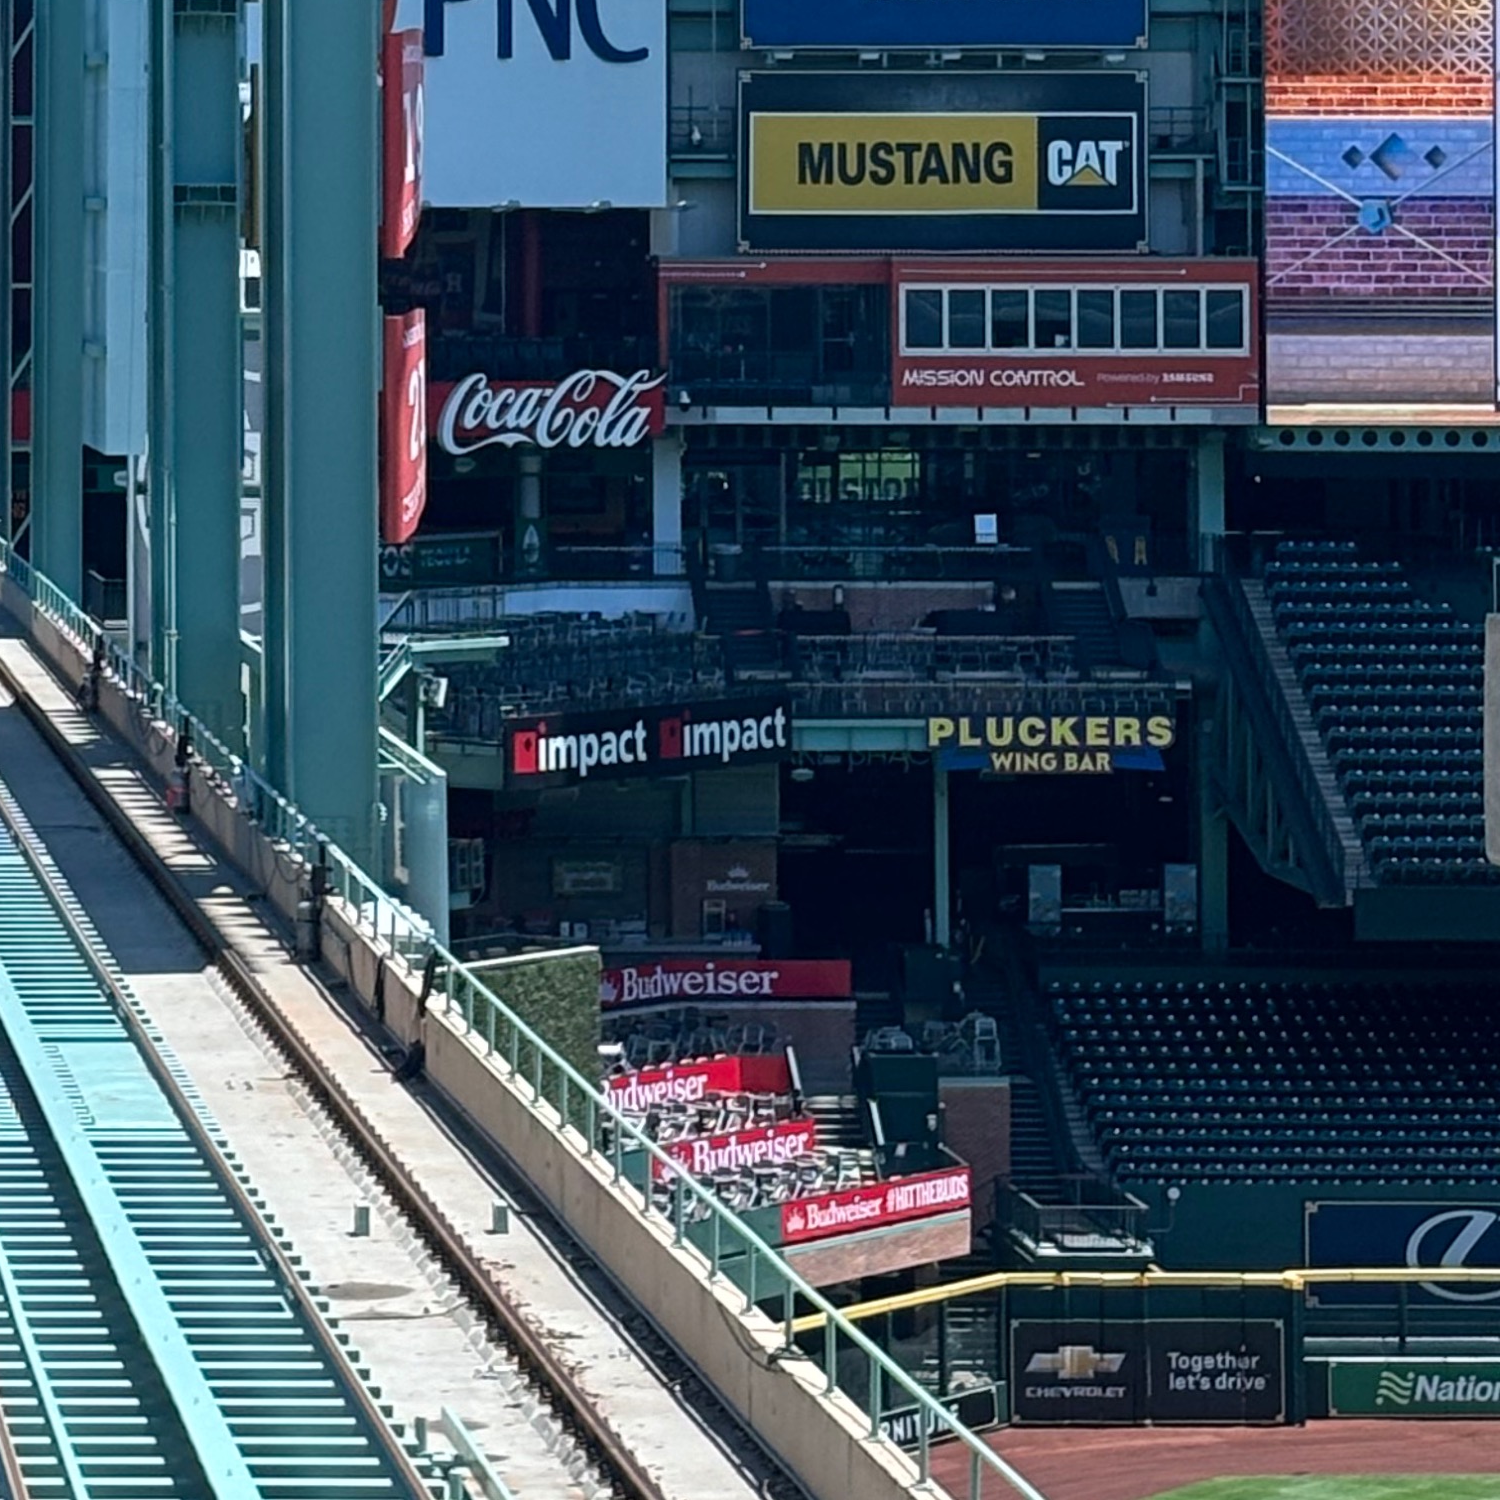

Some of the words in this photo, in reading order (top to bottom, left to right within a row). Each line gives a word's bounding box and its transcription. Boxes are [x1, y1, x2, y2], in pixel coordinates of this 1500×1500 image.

[797, 141, 1013, 186] MUSTANG
[1047, 140, 1124, 187] CAT
[902, 368, 985, 387] MISSION
[990, 369, 1086, 387] CONTROL
[437, 368, 668, 456] Coca-Cola
[538, 719, 648, 778] impact
[683, 706, 787, 763] impact
[928, 716, 1174, 748] PLUCKERS
[990, 751, 1057, 772] WING
[1064, 751, 1112, 771] BAR
[706, 879, 771, 892] Budweiser
[621, 961, 780, 1002] Budweiser
[691, 1129, 810, 1173] Budweiser
[806, 1195, 883, 1229] Budweiser
[886, 1174, 969, 1213] #HITTHEBUDS
[1167, 1351, 1260, 1373] Together
[1025, 1386, 1127, 1398] CHEVROLET
[1168, 1372, 1210, 1390] let's
[1215, 1372, 1266, 1391] drive
